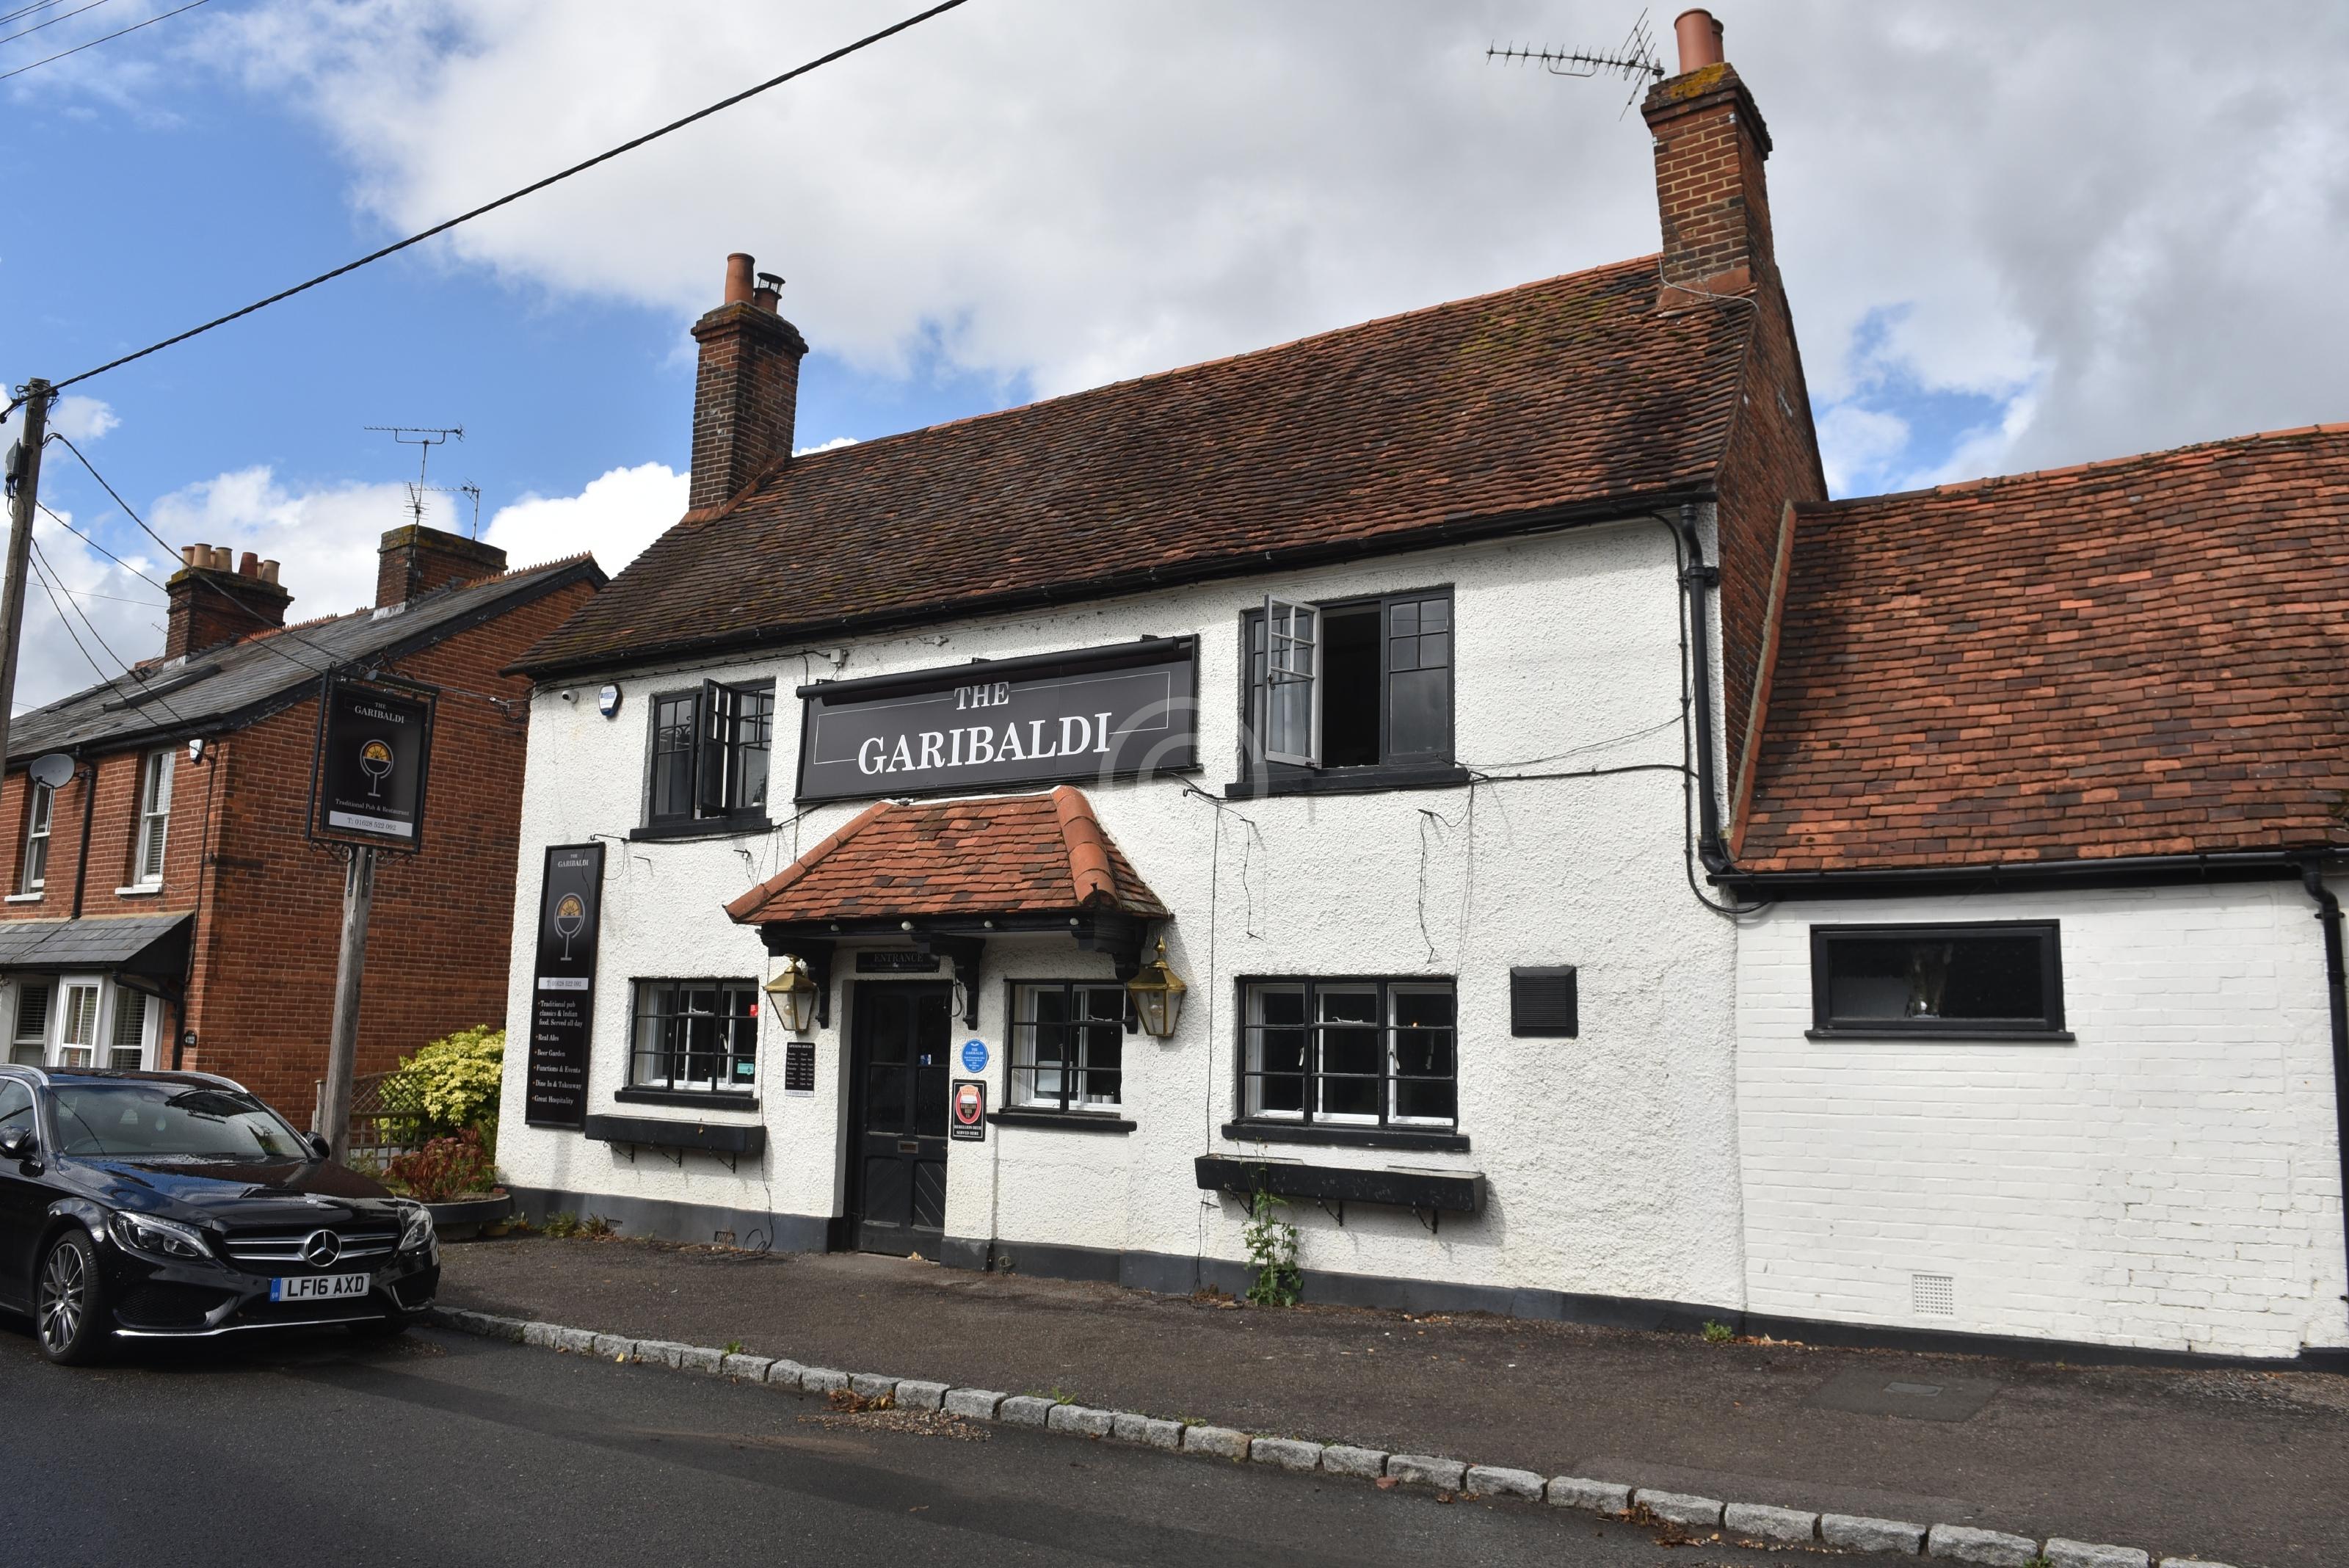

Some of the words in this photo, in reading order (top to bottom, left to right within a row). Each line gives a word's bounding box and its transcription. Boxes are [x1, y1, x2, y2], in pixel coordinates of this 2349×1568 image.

[954, 681, 1009, 711] THE
[355, 705, 404, 724] GARIBALDI
[857, 712, 1112, 775] GARIBALDI
[335, 799, 364, 809] Traditional
[382, 807, 410, 816] Restaurant
[558, 859, 589, 867] GARIBALDI
[874, 954, 923, 962] ENTRANCE
[287, 1279, 328, 1297] LF16
[333, 1276, 364, 1294] AXD
